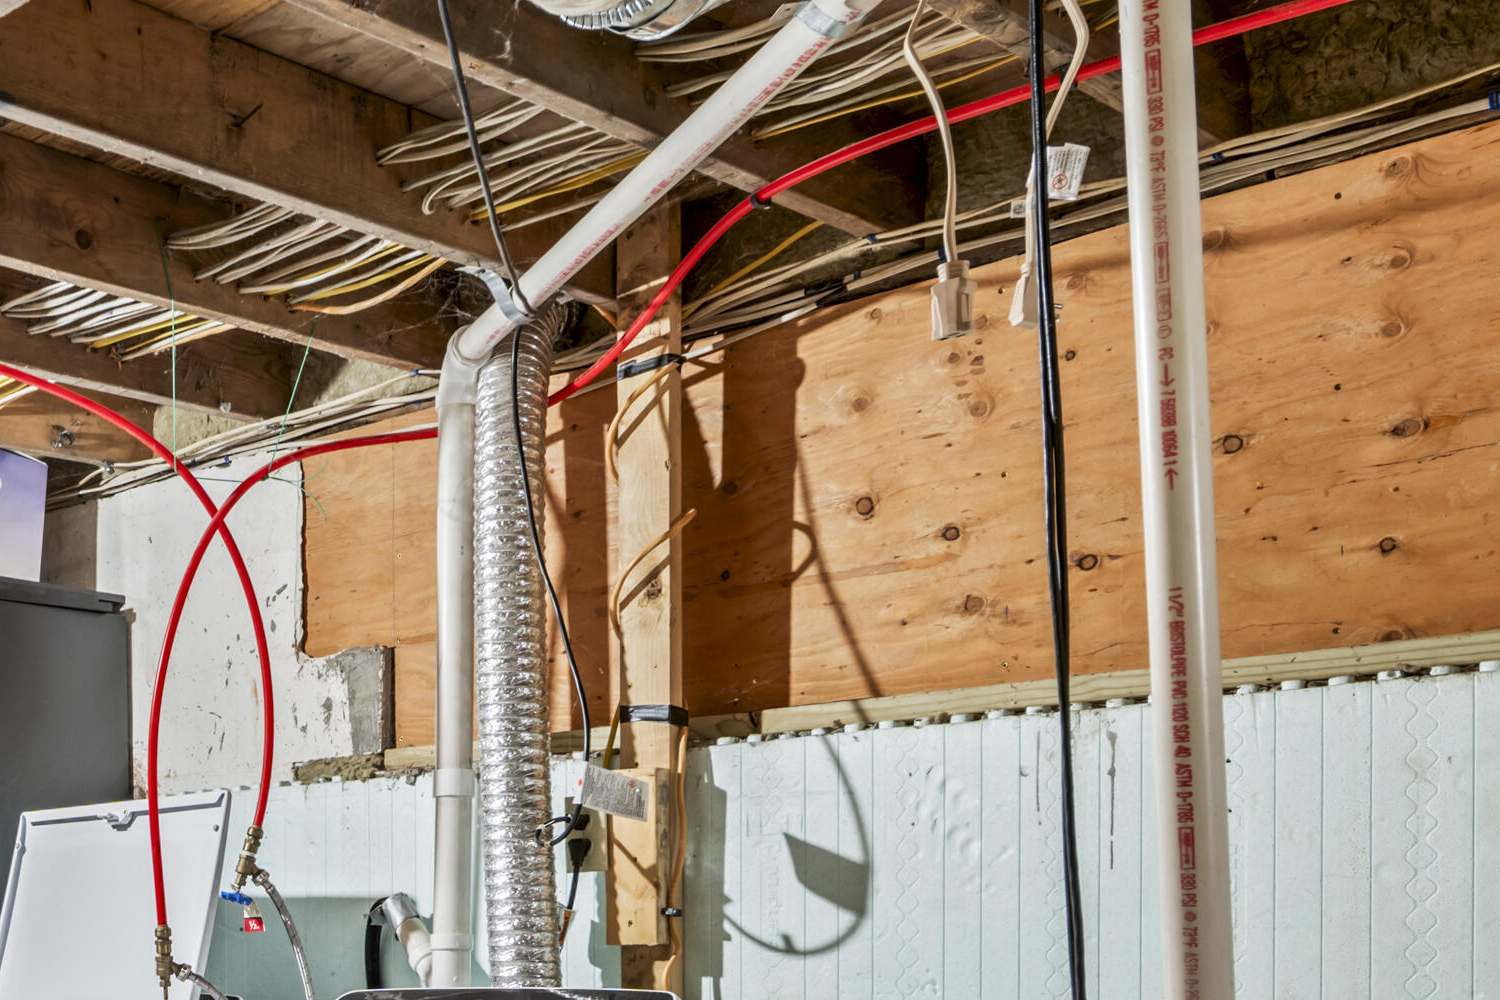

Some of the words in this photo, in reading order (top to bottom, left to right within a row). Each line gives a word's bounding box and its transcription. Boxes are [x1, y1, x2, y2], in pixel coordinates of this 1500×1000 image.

[1142, 13, 1161, 47] D-1785
[1148, 96, 1164, 115] 330
[1148, 117, 1164, 132] PSI
[1151, 178, 1167, 201] ASTM
[1169, 620, 1187, 677] BRISTOLPIPE
[1172, 680, 1188, 699] PVC
[1172, 702, 1188, 722] 1120
[1172, 724, 1190, 743] SCH
[1174, 745, 1191, 758] 40
[1175, 763, 1192, 787] ASTM
[1176, 791, 1194, 823] D-1785
[1180, 873, 1196, 890] 330
[1181, 893, 1196, 907] PSI
[1184, 951, 1199, 975] ASTM
